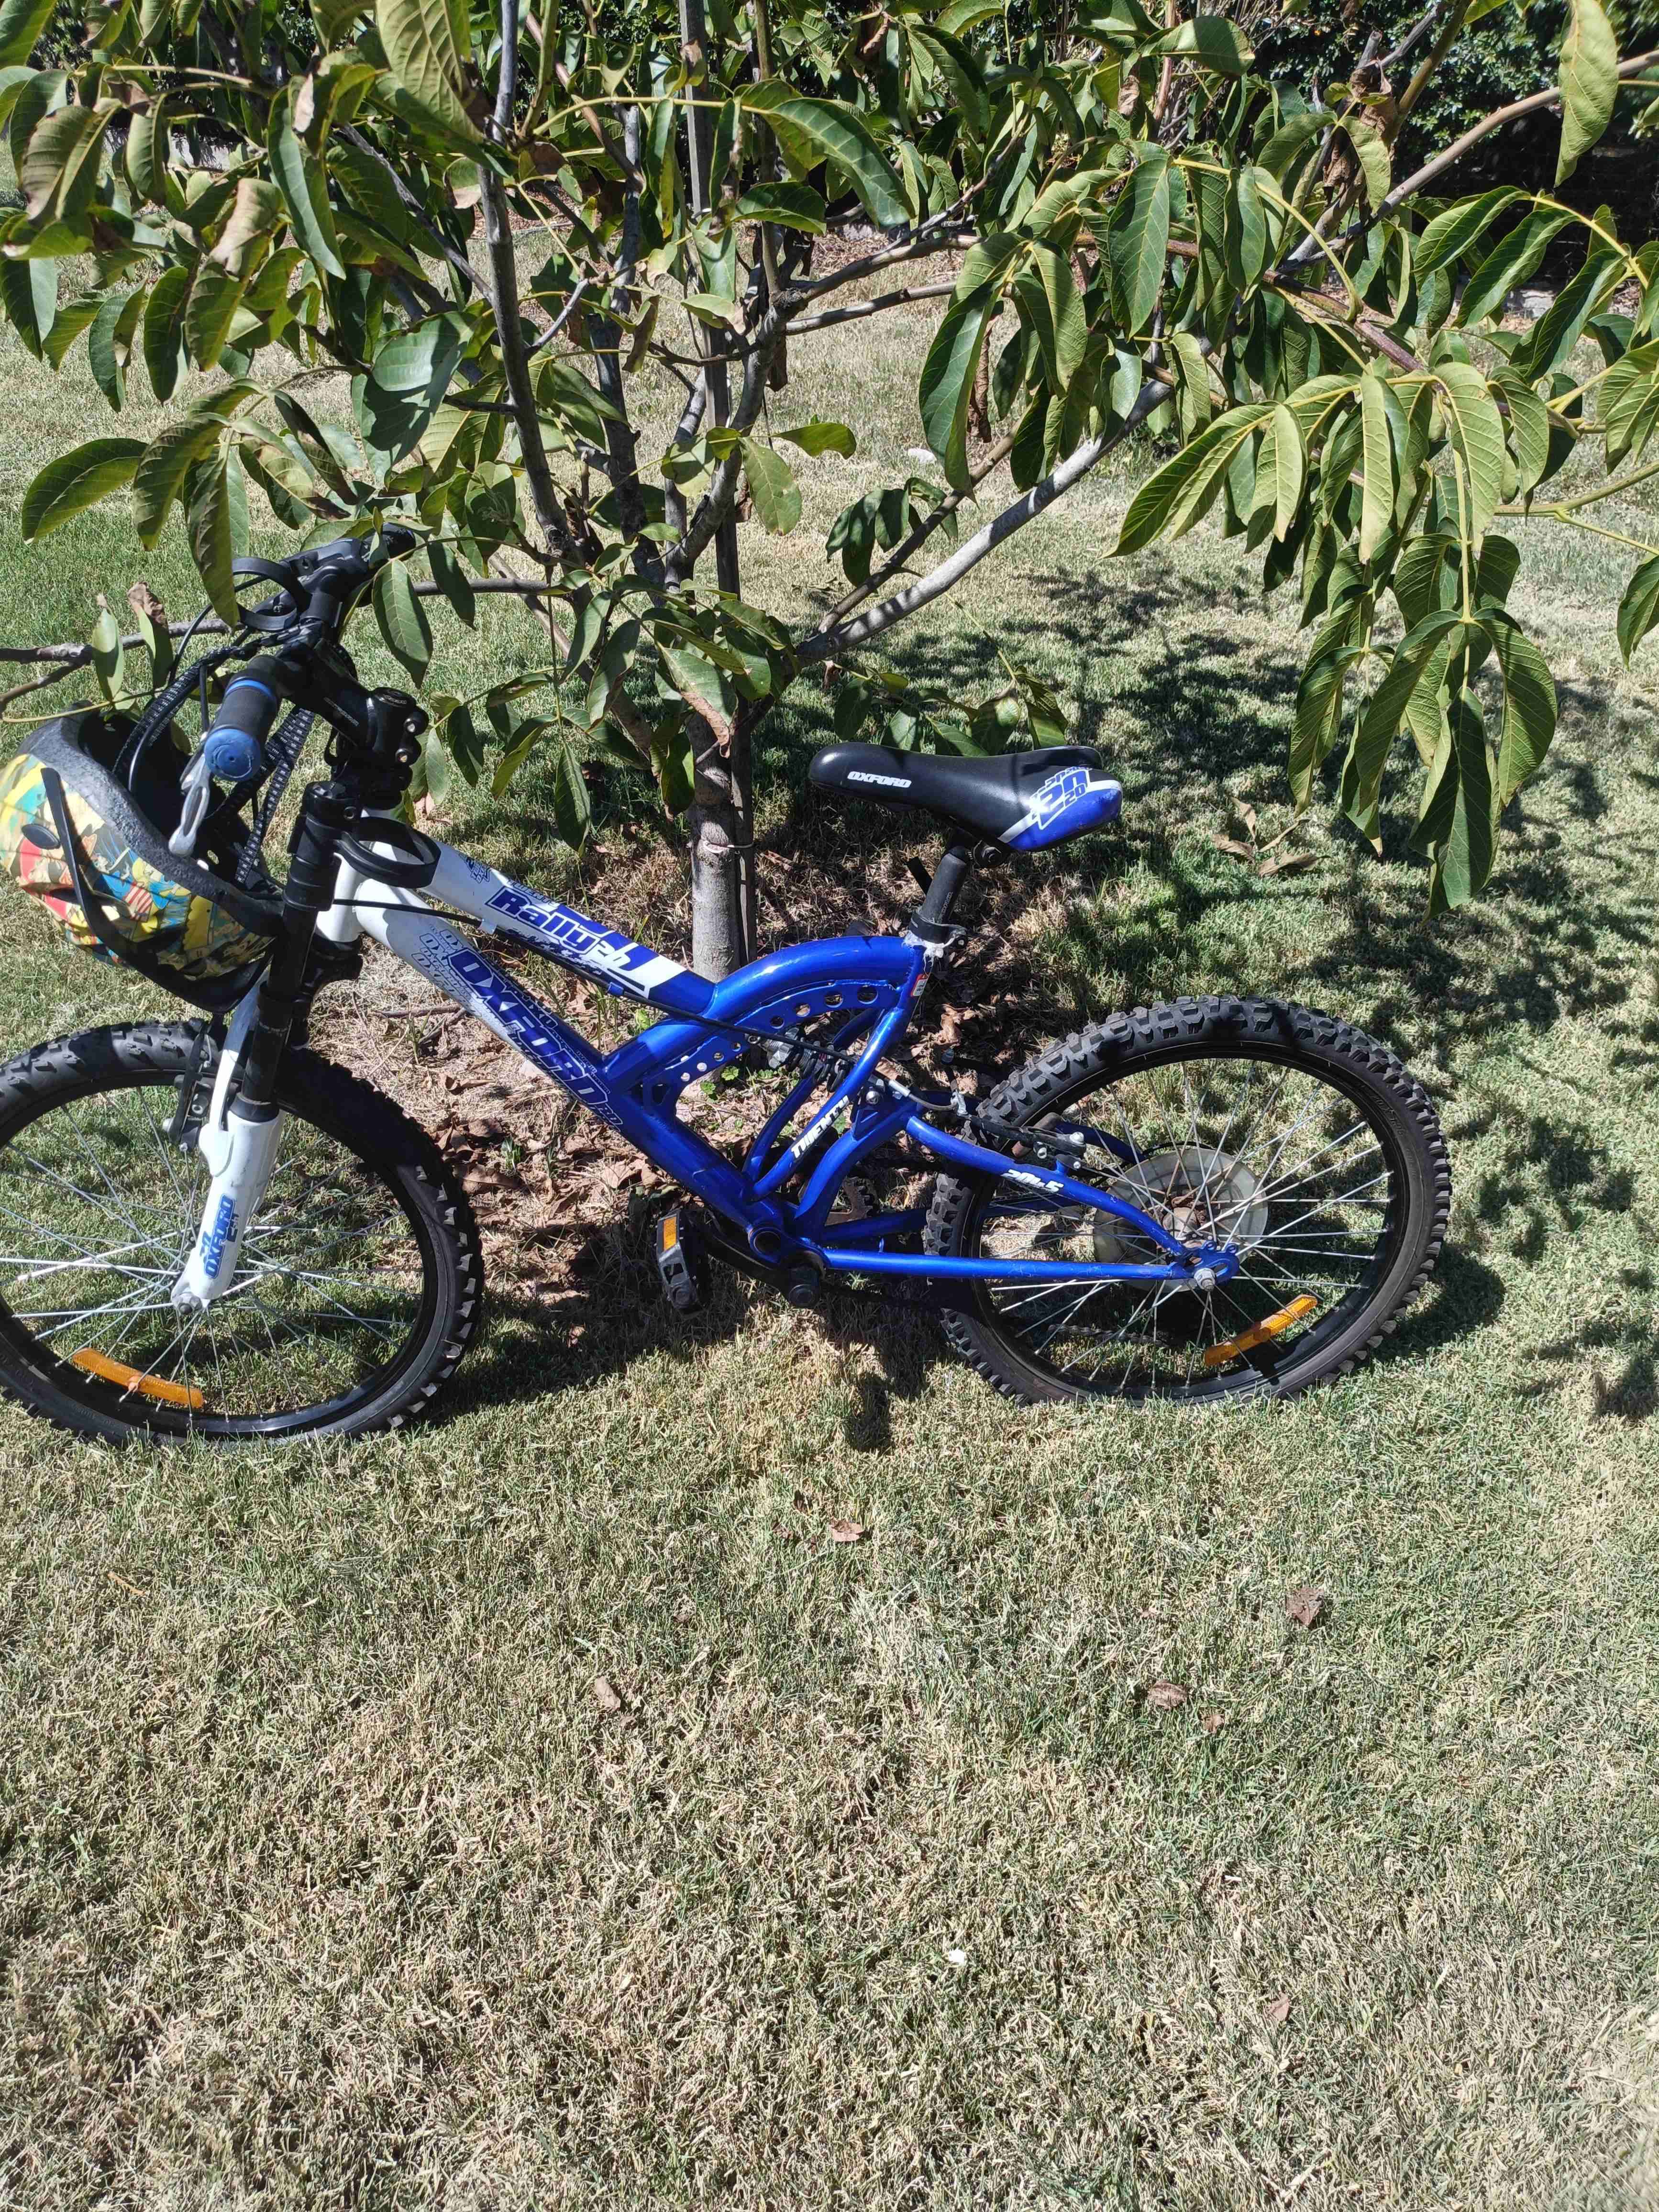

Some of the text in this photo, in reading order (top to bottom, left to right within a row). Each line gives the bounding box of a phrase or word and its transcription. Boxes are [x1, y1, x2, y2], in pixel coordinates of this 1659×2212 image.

[847, 771, 912, 788] OXFORD
[485, 886, 602, 955] Rally
[448, 948, 608, 1105] OXFORD
[791, 1095, 850, 1159] TWENTY
[205, 1194, 235, 1279] OXFORD
